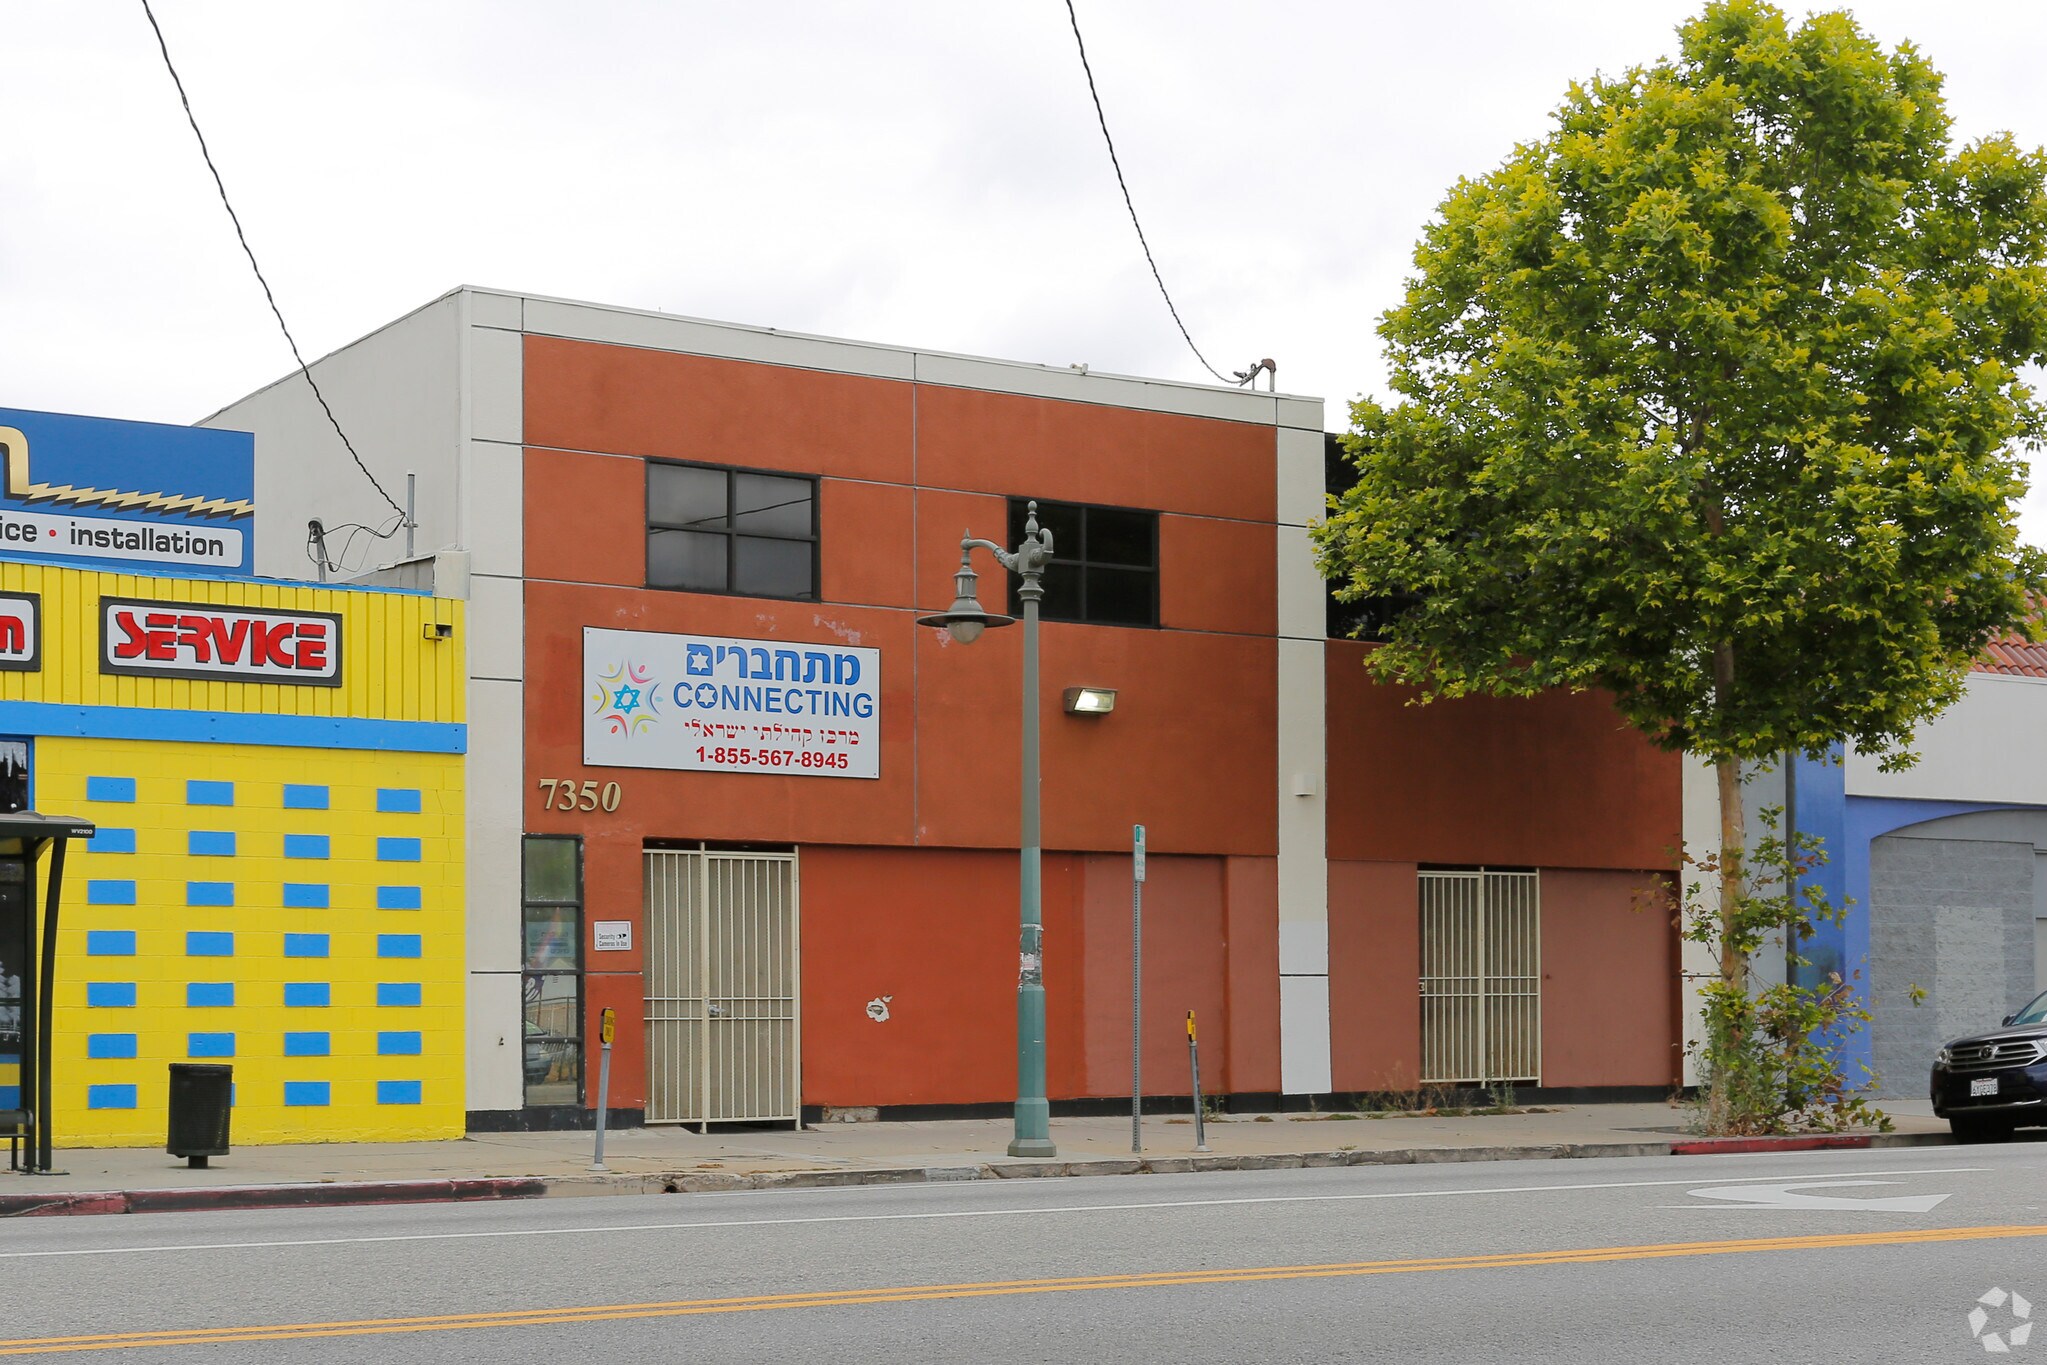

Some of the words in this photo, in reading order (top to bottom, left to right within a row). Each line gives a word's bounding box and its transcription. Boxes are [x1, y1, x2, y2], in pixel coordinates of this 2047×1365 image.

[70, 521, 224, 556] installation
[114, 611, 327, 669] SERVICE
[686, 642, 861, 685] מתחברים
[673, 681, 873, 718] CONNECTING
[696, 746, 849, 769] 1-855-567-8945
[538, 778, 622, 812] 7350
